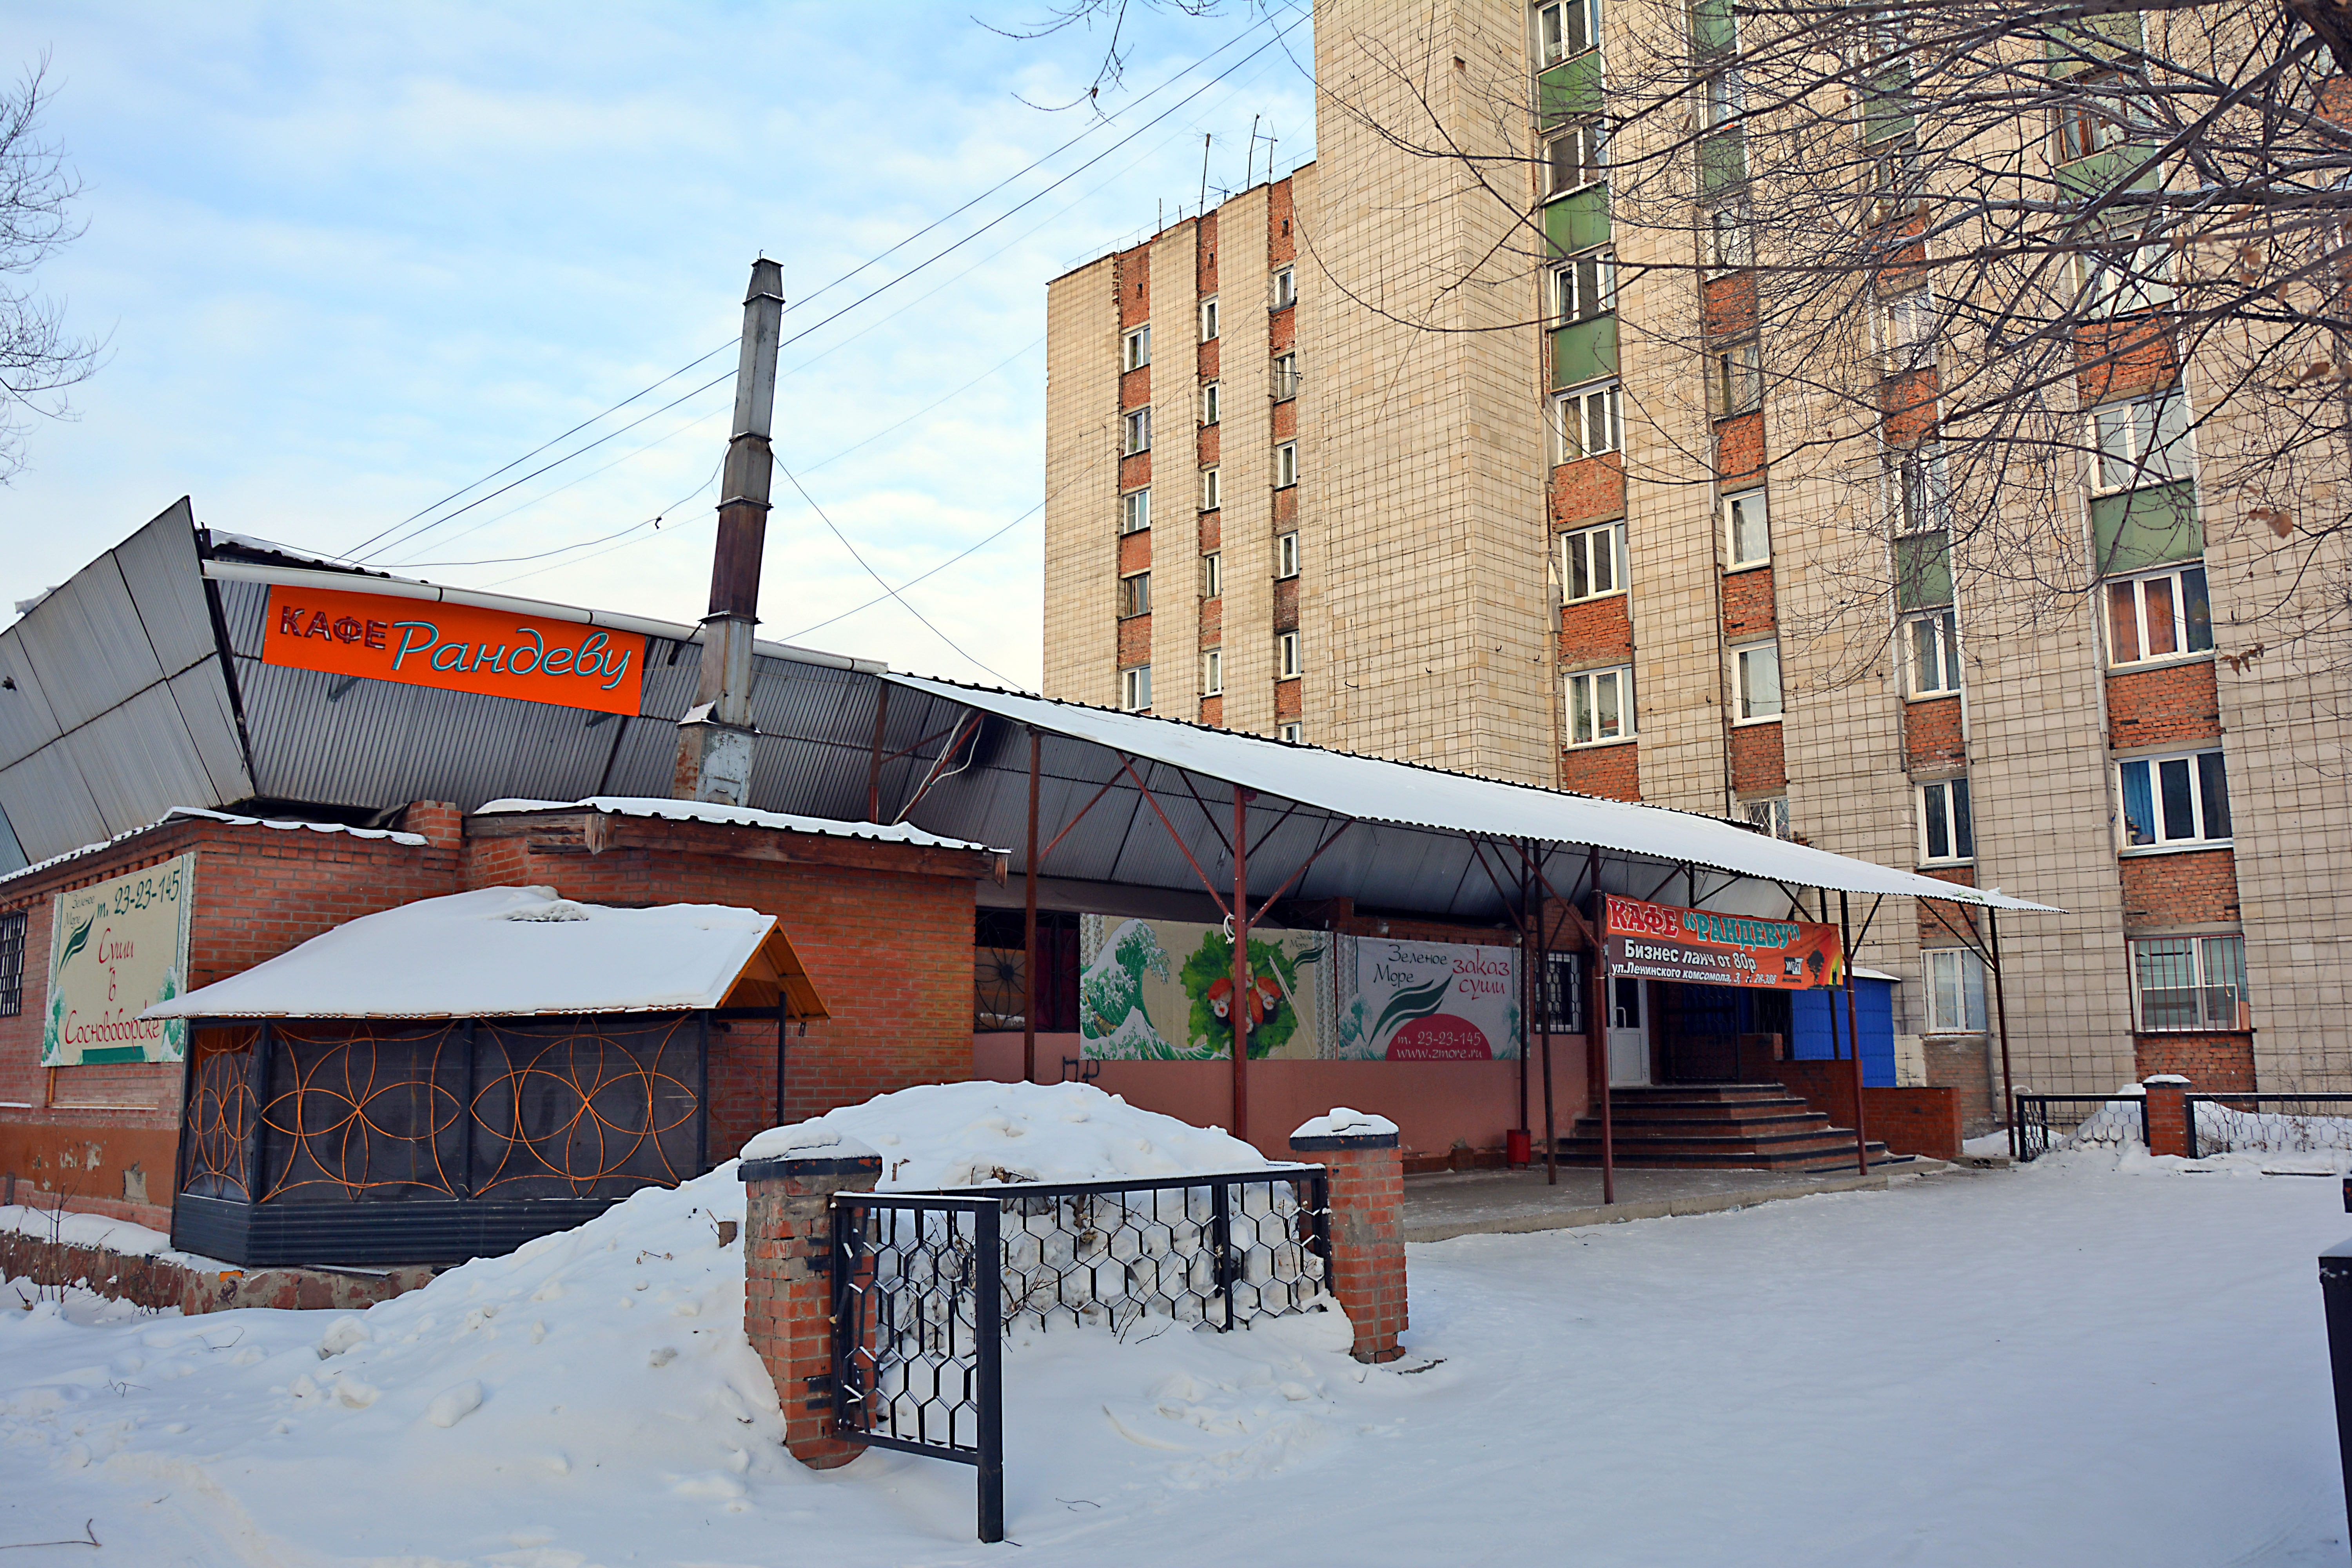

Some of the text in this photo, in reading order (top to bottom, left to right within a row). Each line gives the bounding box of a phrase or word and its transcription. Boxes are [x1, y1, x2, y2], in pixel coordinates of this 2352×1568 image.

[280, 606, 631, 690] КАФЕ Рандеву
[114, 869, 180, 915] 23-23-145
[1608, 898, 1679, 938] КАФЕ
[98, 927, 134, 972] Суши
[1388, 944, 1448, 965] Зеленое
[1452, 949, 1510, 976] заказ
[1625, 938, 1757, 974] Бизнес ланч от 80р
[1374, 963, 1415, 989] Море
[1612, 962, 1681, 978] ул.Ленинского
[1459, 979, 1505, 1000] суши
[1417, 1031, 1481, 1046] 23-23-145
[1397, 1049, 1483, 1059] www.zmore.ru
